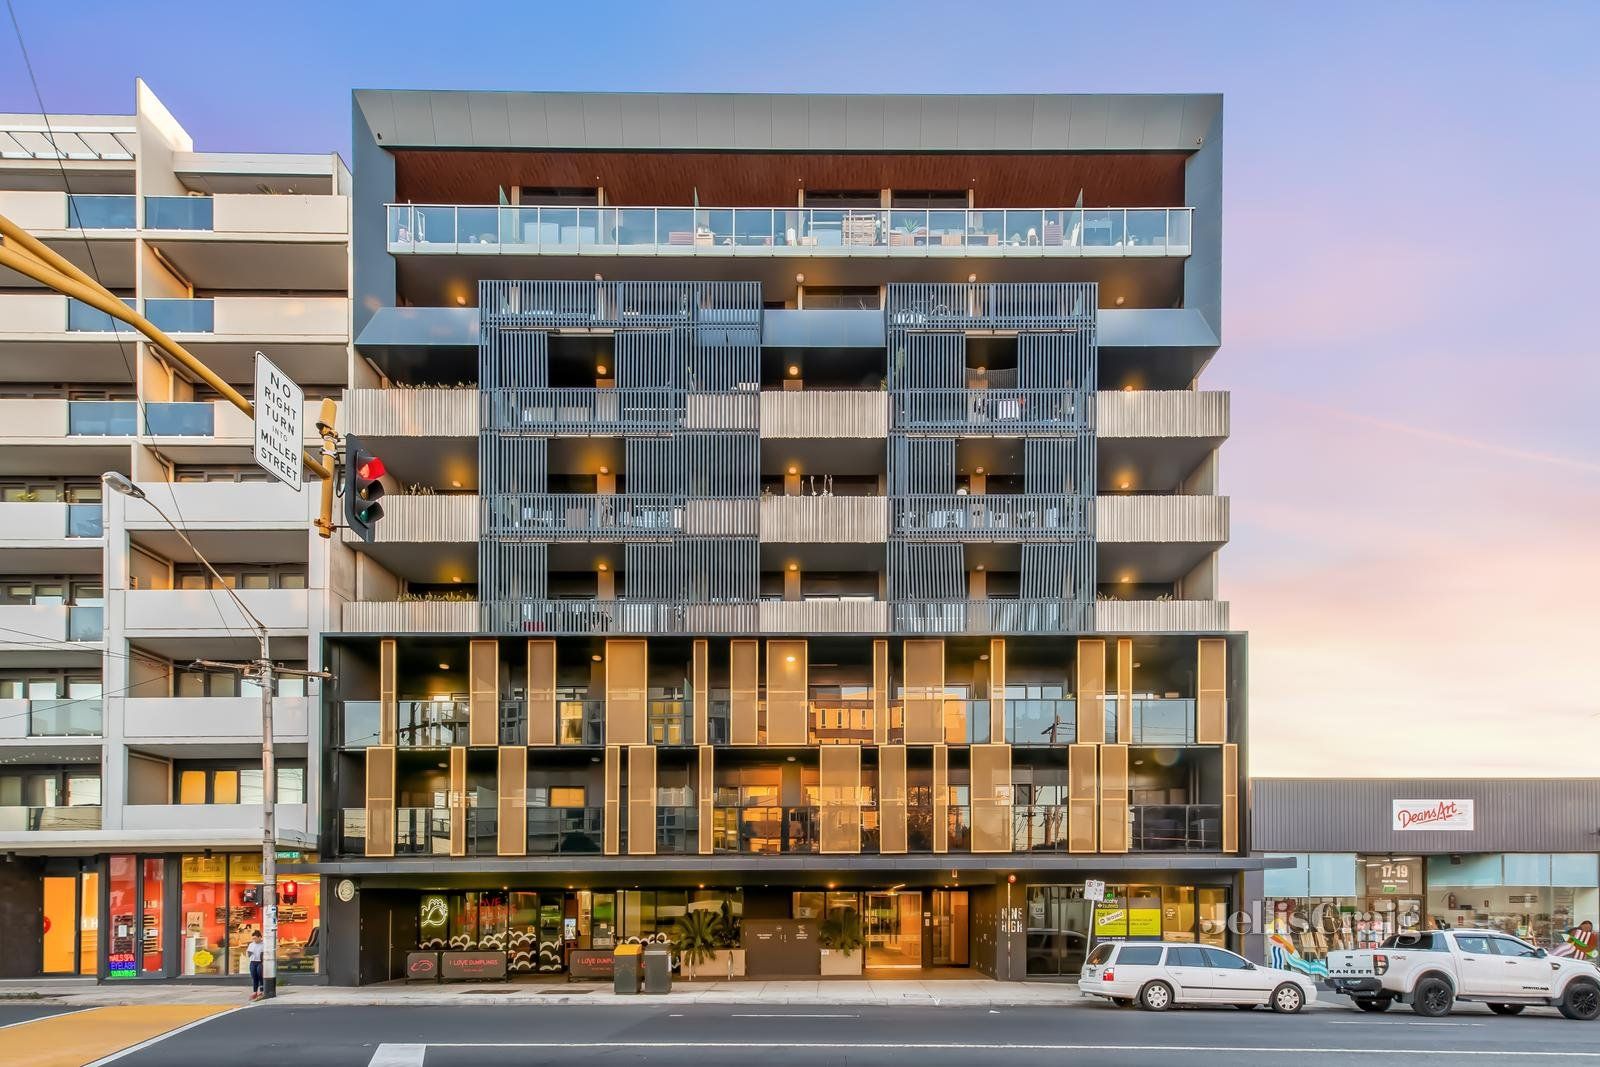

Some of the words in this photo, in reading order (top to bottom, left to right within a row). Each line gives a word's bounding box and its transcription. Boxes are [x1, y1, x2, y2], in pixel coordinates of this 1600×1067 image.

[270, 371, 291, 398] NO
[264, 386, 297, 420] RIGHT
[265, 404, 295, 436] TURN
[260, 429, 297, 465] MILLER
[272, 426, 288, 442] INTO
[260, 447, 298, 482] STREET
[1381, 865, 1408, 877] 17-19
[1001, 907, 1023, 920] NINE
[1001, 920, 1023, 933] HIGH
